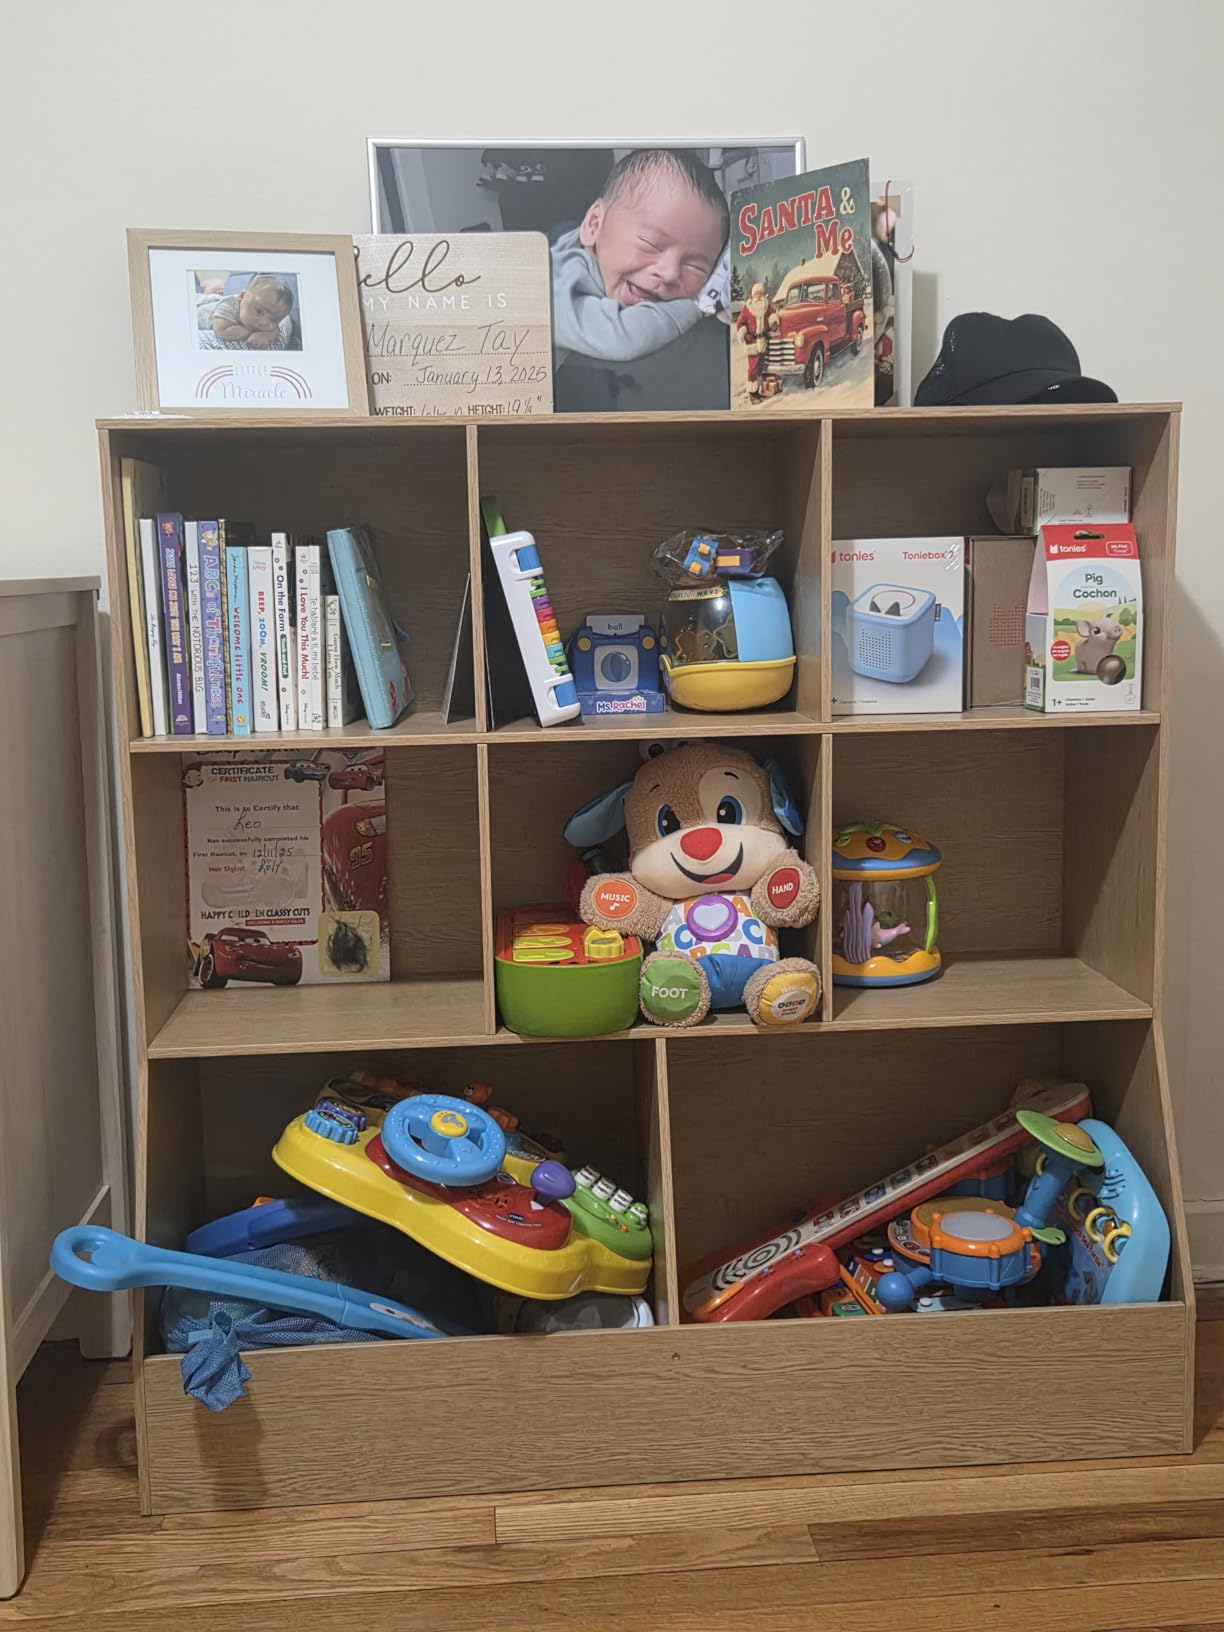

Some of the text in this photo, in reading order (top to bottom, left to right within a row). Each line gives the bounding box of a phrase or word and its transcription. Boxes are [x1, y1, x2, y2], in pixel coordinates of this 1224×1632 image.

[739, 185, 856, 257] SANTA &
[814, 219, 854, 260] Me
[354, 240, 482, 293] ello
[363, 292, 508, 312] MY NAME IS
[367, 320, 530, 366] Marquez Tay
[371, 371, 392, 385] ON:
[416, 365, 480, 394] January
[510, 366, 548, 384] 2025
[215, 381, 288, 400] Miracle
[840, 551, 875, 561] tonies
[902, 551, 946, 560] Toniebox
[1060, 544, 1087, 553] tonies
[189, 563, 199, 584] 123
[1085, 573, 1103, 585] Pig
[1073, 588, 1117, 598] Cochon
[277, 575, 287, 632] On the Farm
[300, 592, 308, 613] Love
[191, 609, 199, 622] THE
[300, 616, 308, 632] You
[311, 606, 319, 635] hablaré
[203, 554, 224, 708] ABCs of Thankfulness
[192, 626, 203, 673] NOTORIOUS
[257, 591, 269, 691] BEEP, ZOOM, VROOM!
[301, 633, 309, 651] This
[233, 606, 244, 705] welcome little one
[312, 651, 319, 661] mi
[301, 653, 309, 680] Much!
[195, 676, 204, 692] BIG
[613, 697, 646, 711] Rachel
[1053, 698, 1062, 706] 1+
[211, 766, 275, 775] CERTIFICATE
[243, 774, 280, 783] HAIRCUT
[253, 804, 281, 812] Certify
[234, 807, 262, 833] Leo
[351, 841, 374, 870] 95
[600, 892, 630, 902] MUSIC
[772, 882, 794, 895] HAND
[201, 911, 226, 920] HAPPY
[266, 909, 291, 918] CLASSY
[293, 908, 311, 917] CUTS
[651, 986, 689, 999] FOOT
